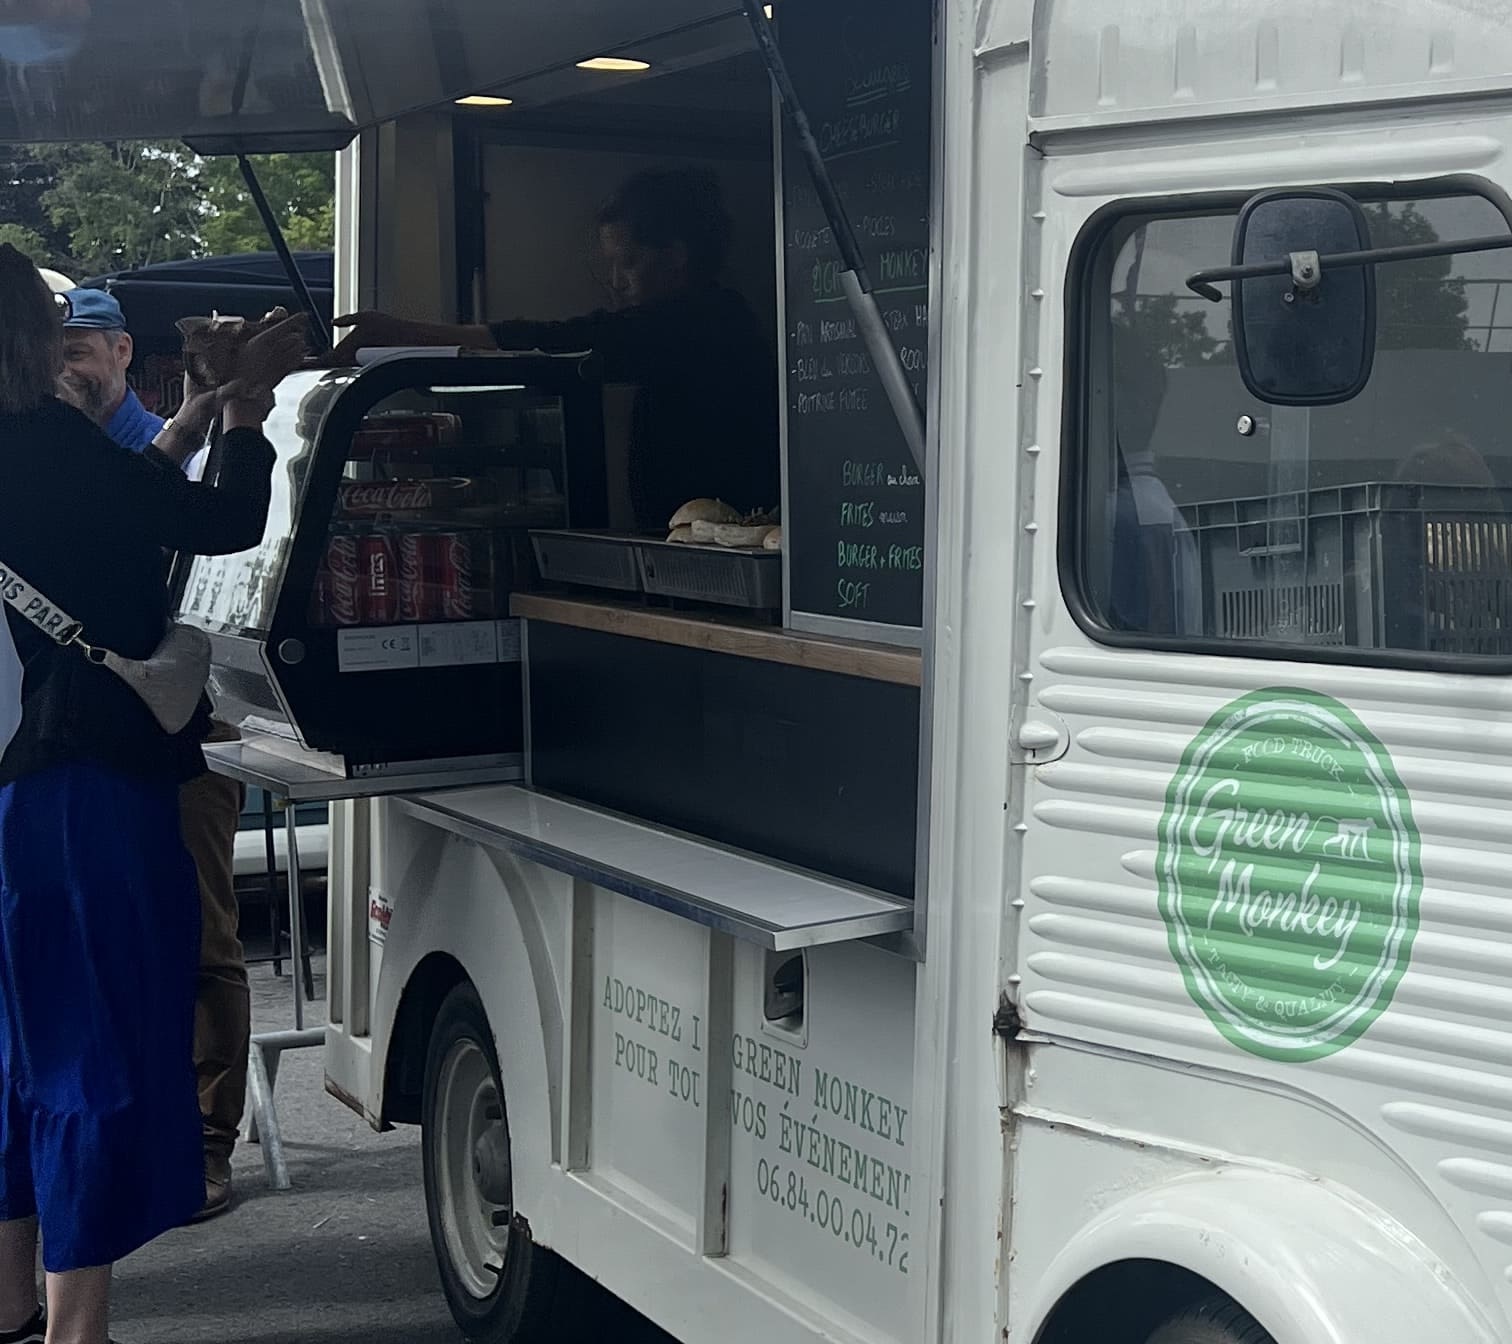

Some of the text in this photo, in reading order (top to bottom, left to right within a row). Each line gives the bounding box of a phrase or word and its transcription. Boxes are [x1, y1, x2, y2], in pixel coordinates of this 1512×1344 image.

[880, 248, 927, 281] MONKEY
[842, 459, 884, 487] BURGER
[840, 501, 874, 528] FRITES
[838, 540, 877, 568] BURGER
[888, 543, 922, 570] FRITES
[838, 578, 871, 608] SOFT
[1290, 737, 1345, 784] TRUCK
[1189, 778, 1314, 873] Green
[1207, 859, 1361, 971] Monkey
[603, 975, 681, 1042] ADOPTEZ
[731, 1033, 801, 1097] GREEN
[814, 1068, 908, 1146] MONKEY
[615, 1032, 658, 1086] POUR
[730, 1089, 766, 1140] VOS
